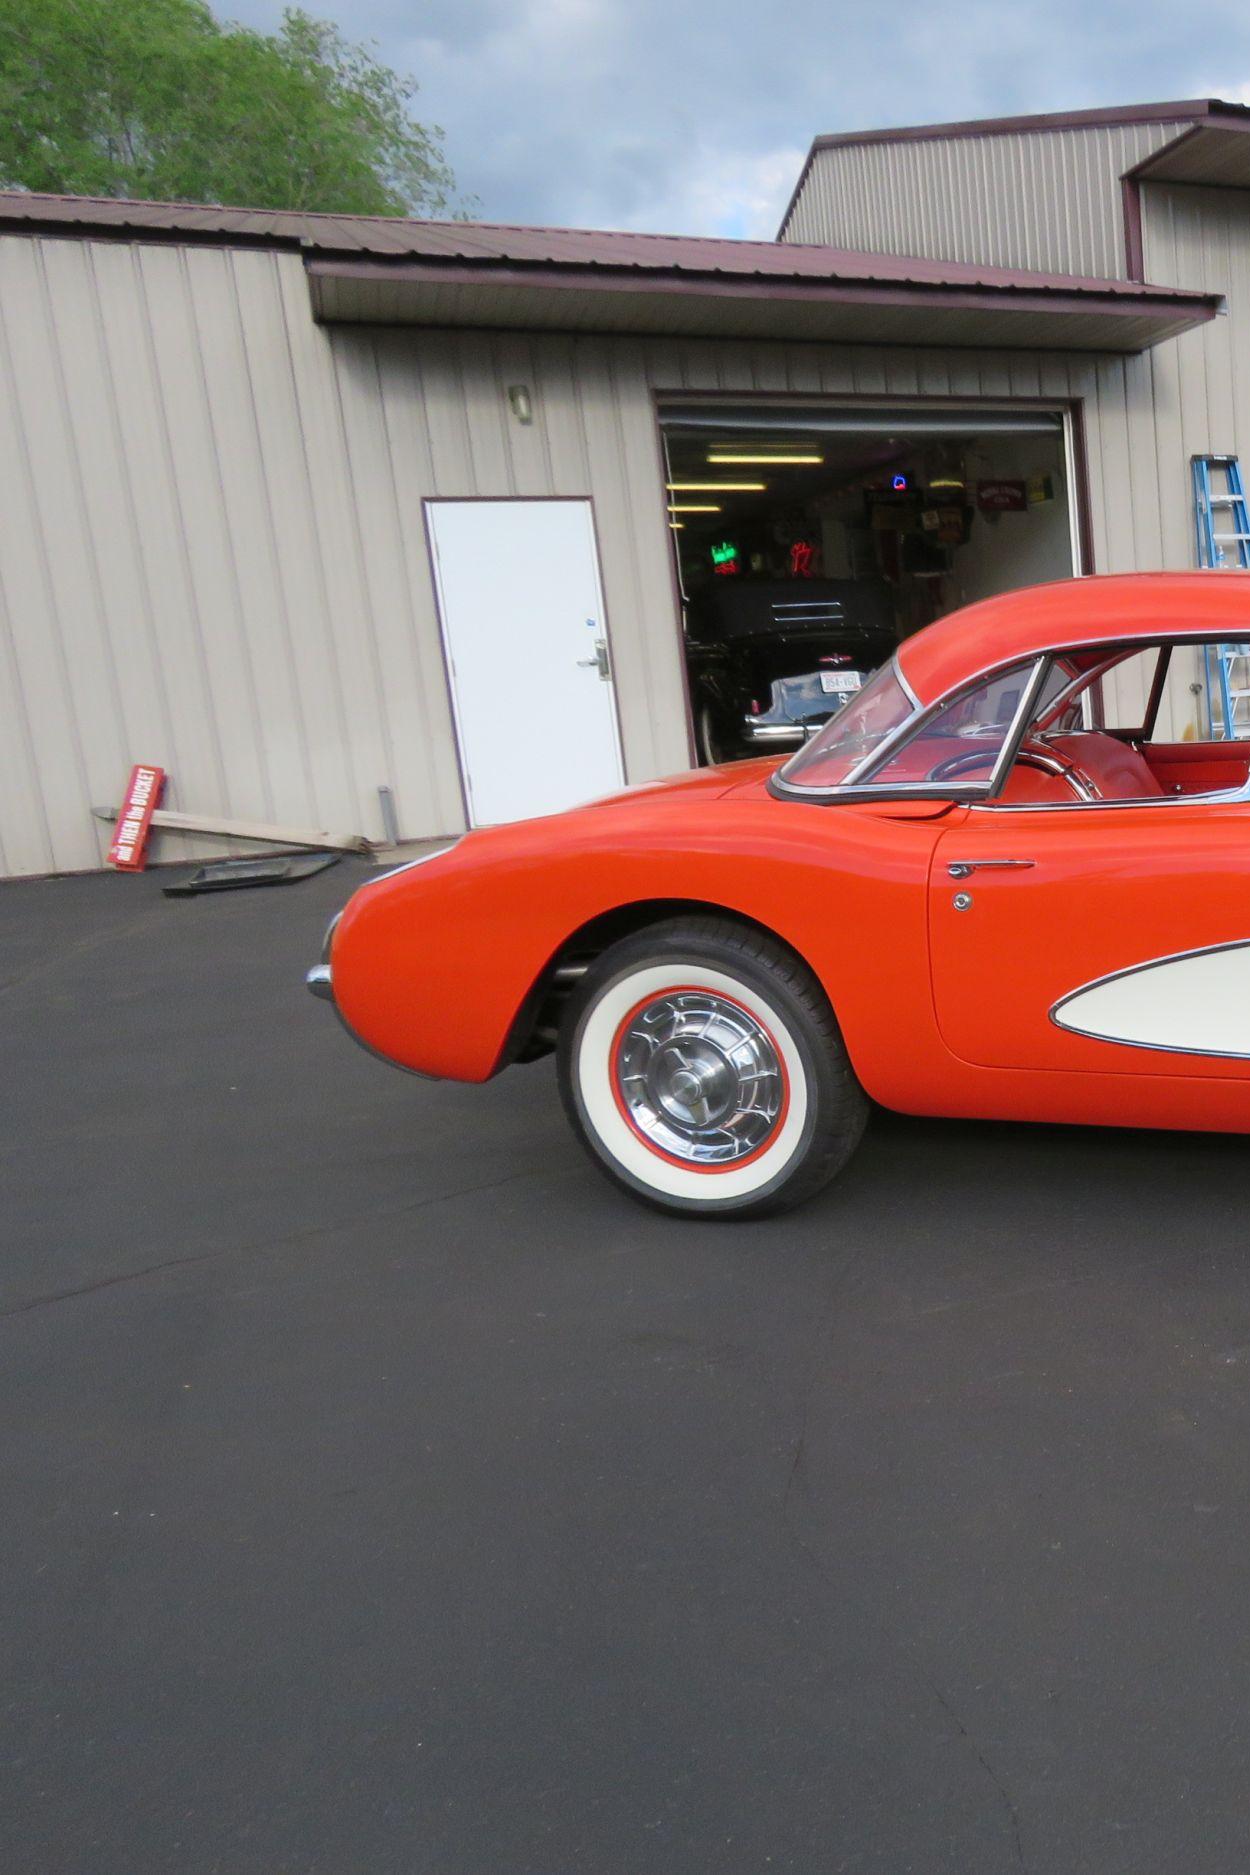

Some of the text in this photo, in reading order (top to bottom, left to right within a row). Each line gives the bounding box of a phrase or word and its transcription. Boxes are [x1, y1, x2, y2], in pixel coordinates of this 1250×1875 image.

[129, 768, 156, 806] BUCKET
[126, 806, 146, 820] the
[118, 820, 141, 845] THEN
